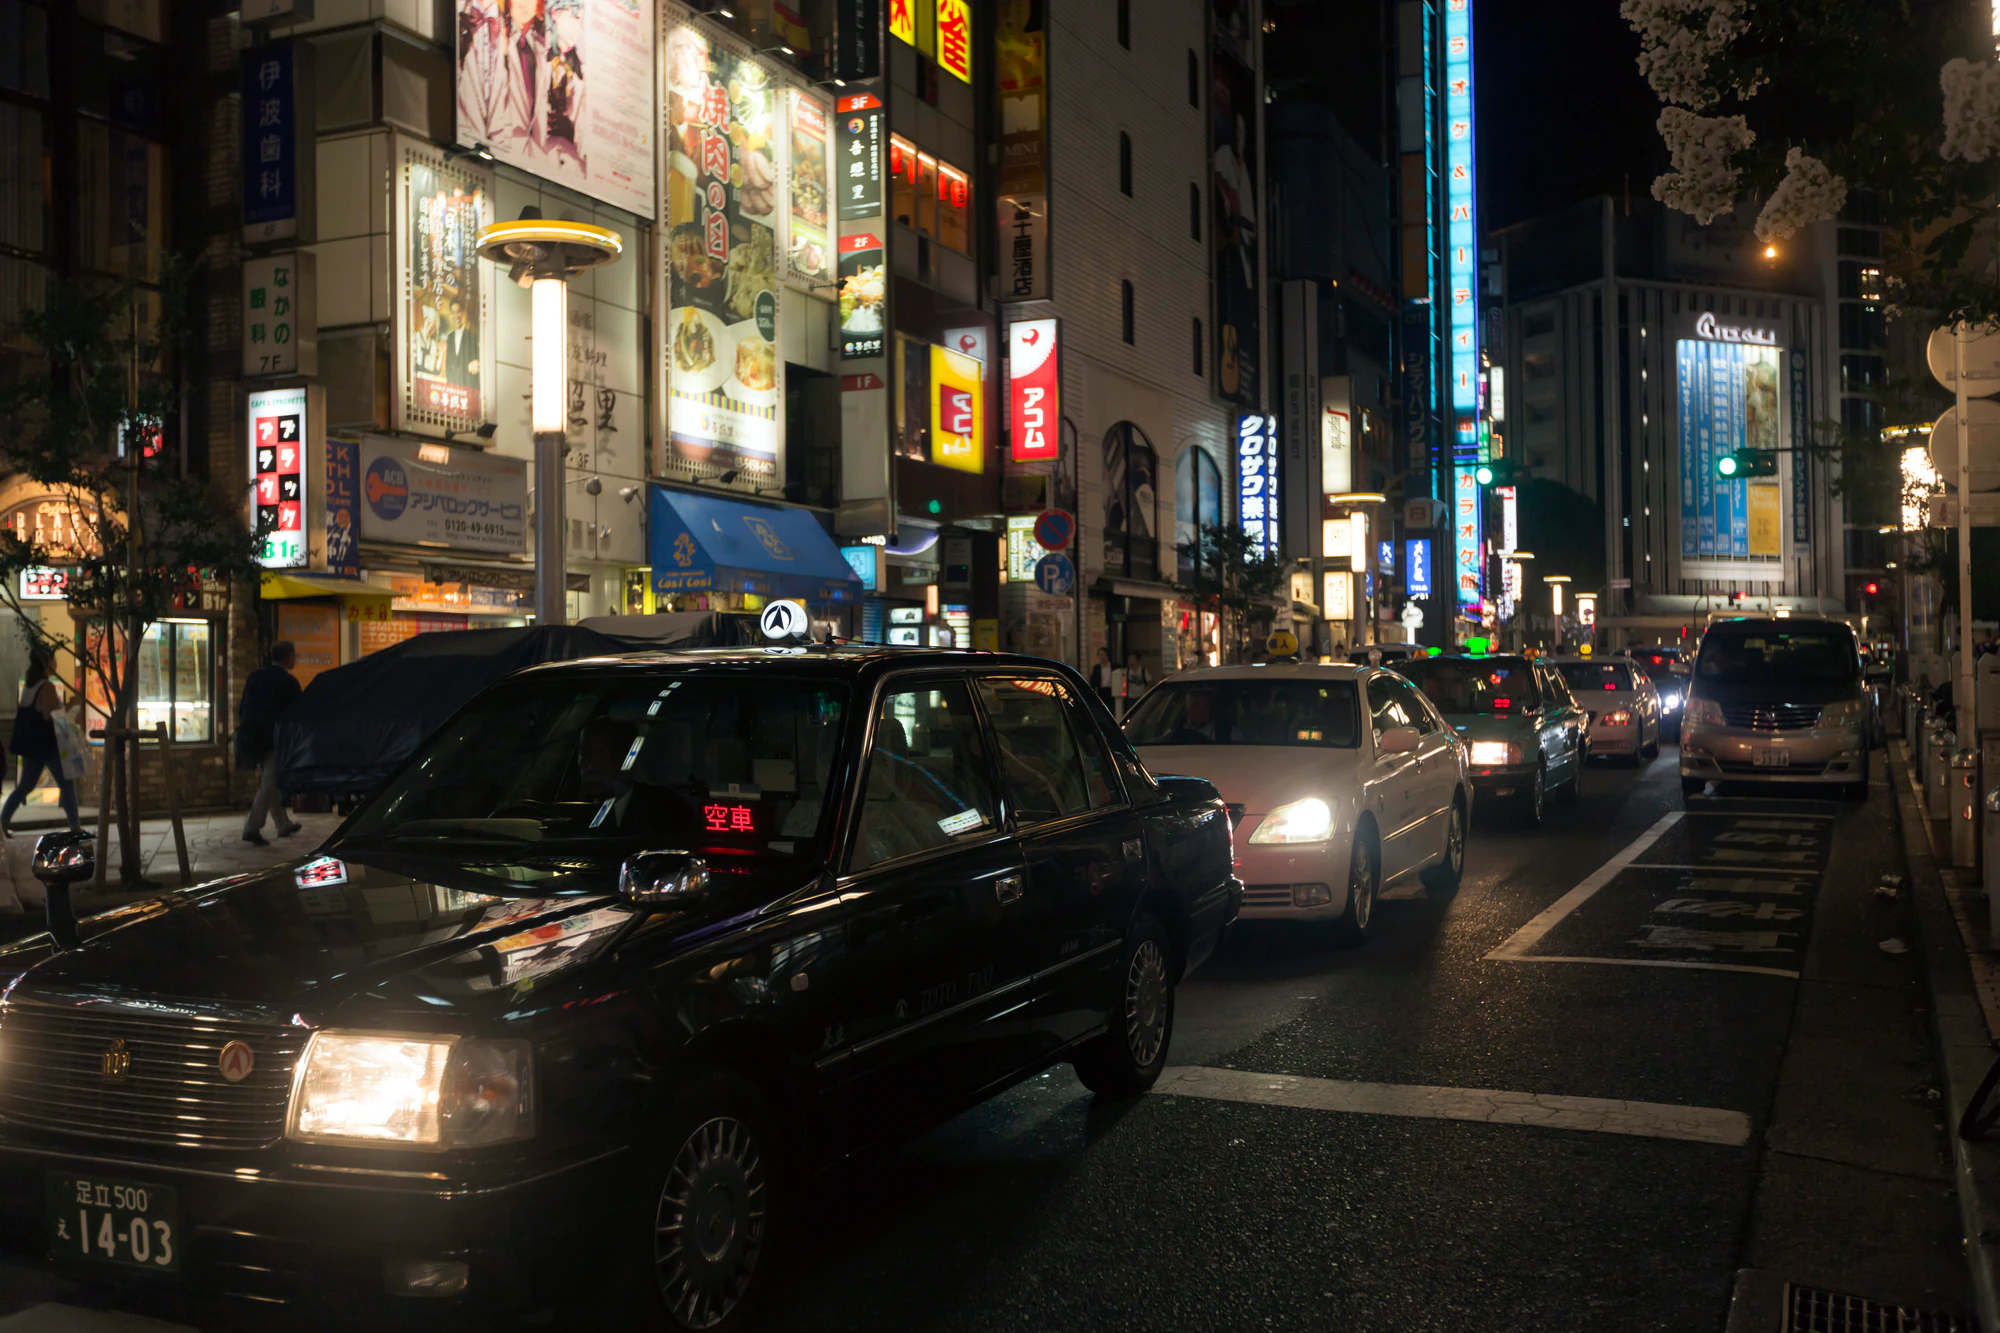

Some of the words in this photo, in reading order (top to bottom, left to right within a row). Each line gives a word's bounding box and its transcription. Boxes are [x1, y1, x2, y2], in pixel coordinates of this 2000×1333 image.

[851, 96, 868, 110] 3F
[258, 60, 282, 199] 伊波歯科
[854, 237, 868, 248] 2F
[274, 267, 290, 344] なかの
[260, 355, 281, 371] 7F
[857, 376, 872, 389] 1F
[1023, 387, 1045, 449] アコム
[279, 420, 297, 529] ブラック
[383, 470, 404, 486] ACB
[445, 519, 504, 536] 0120-49-6915
[1459, 473, 1478, 590] カラオケ館
[261, 541, 300, 560] B1F
[1043, 564, 1060, 591] P
[203, 592, 227, 611] B1F
[704, 803, 754, 833] 空車
[57, 1217, 71, 1241] え
[79, 1209, 173, 1266] 14-03
